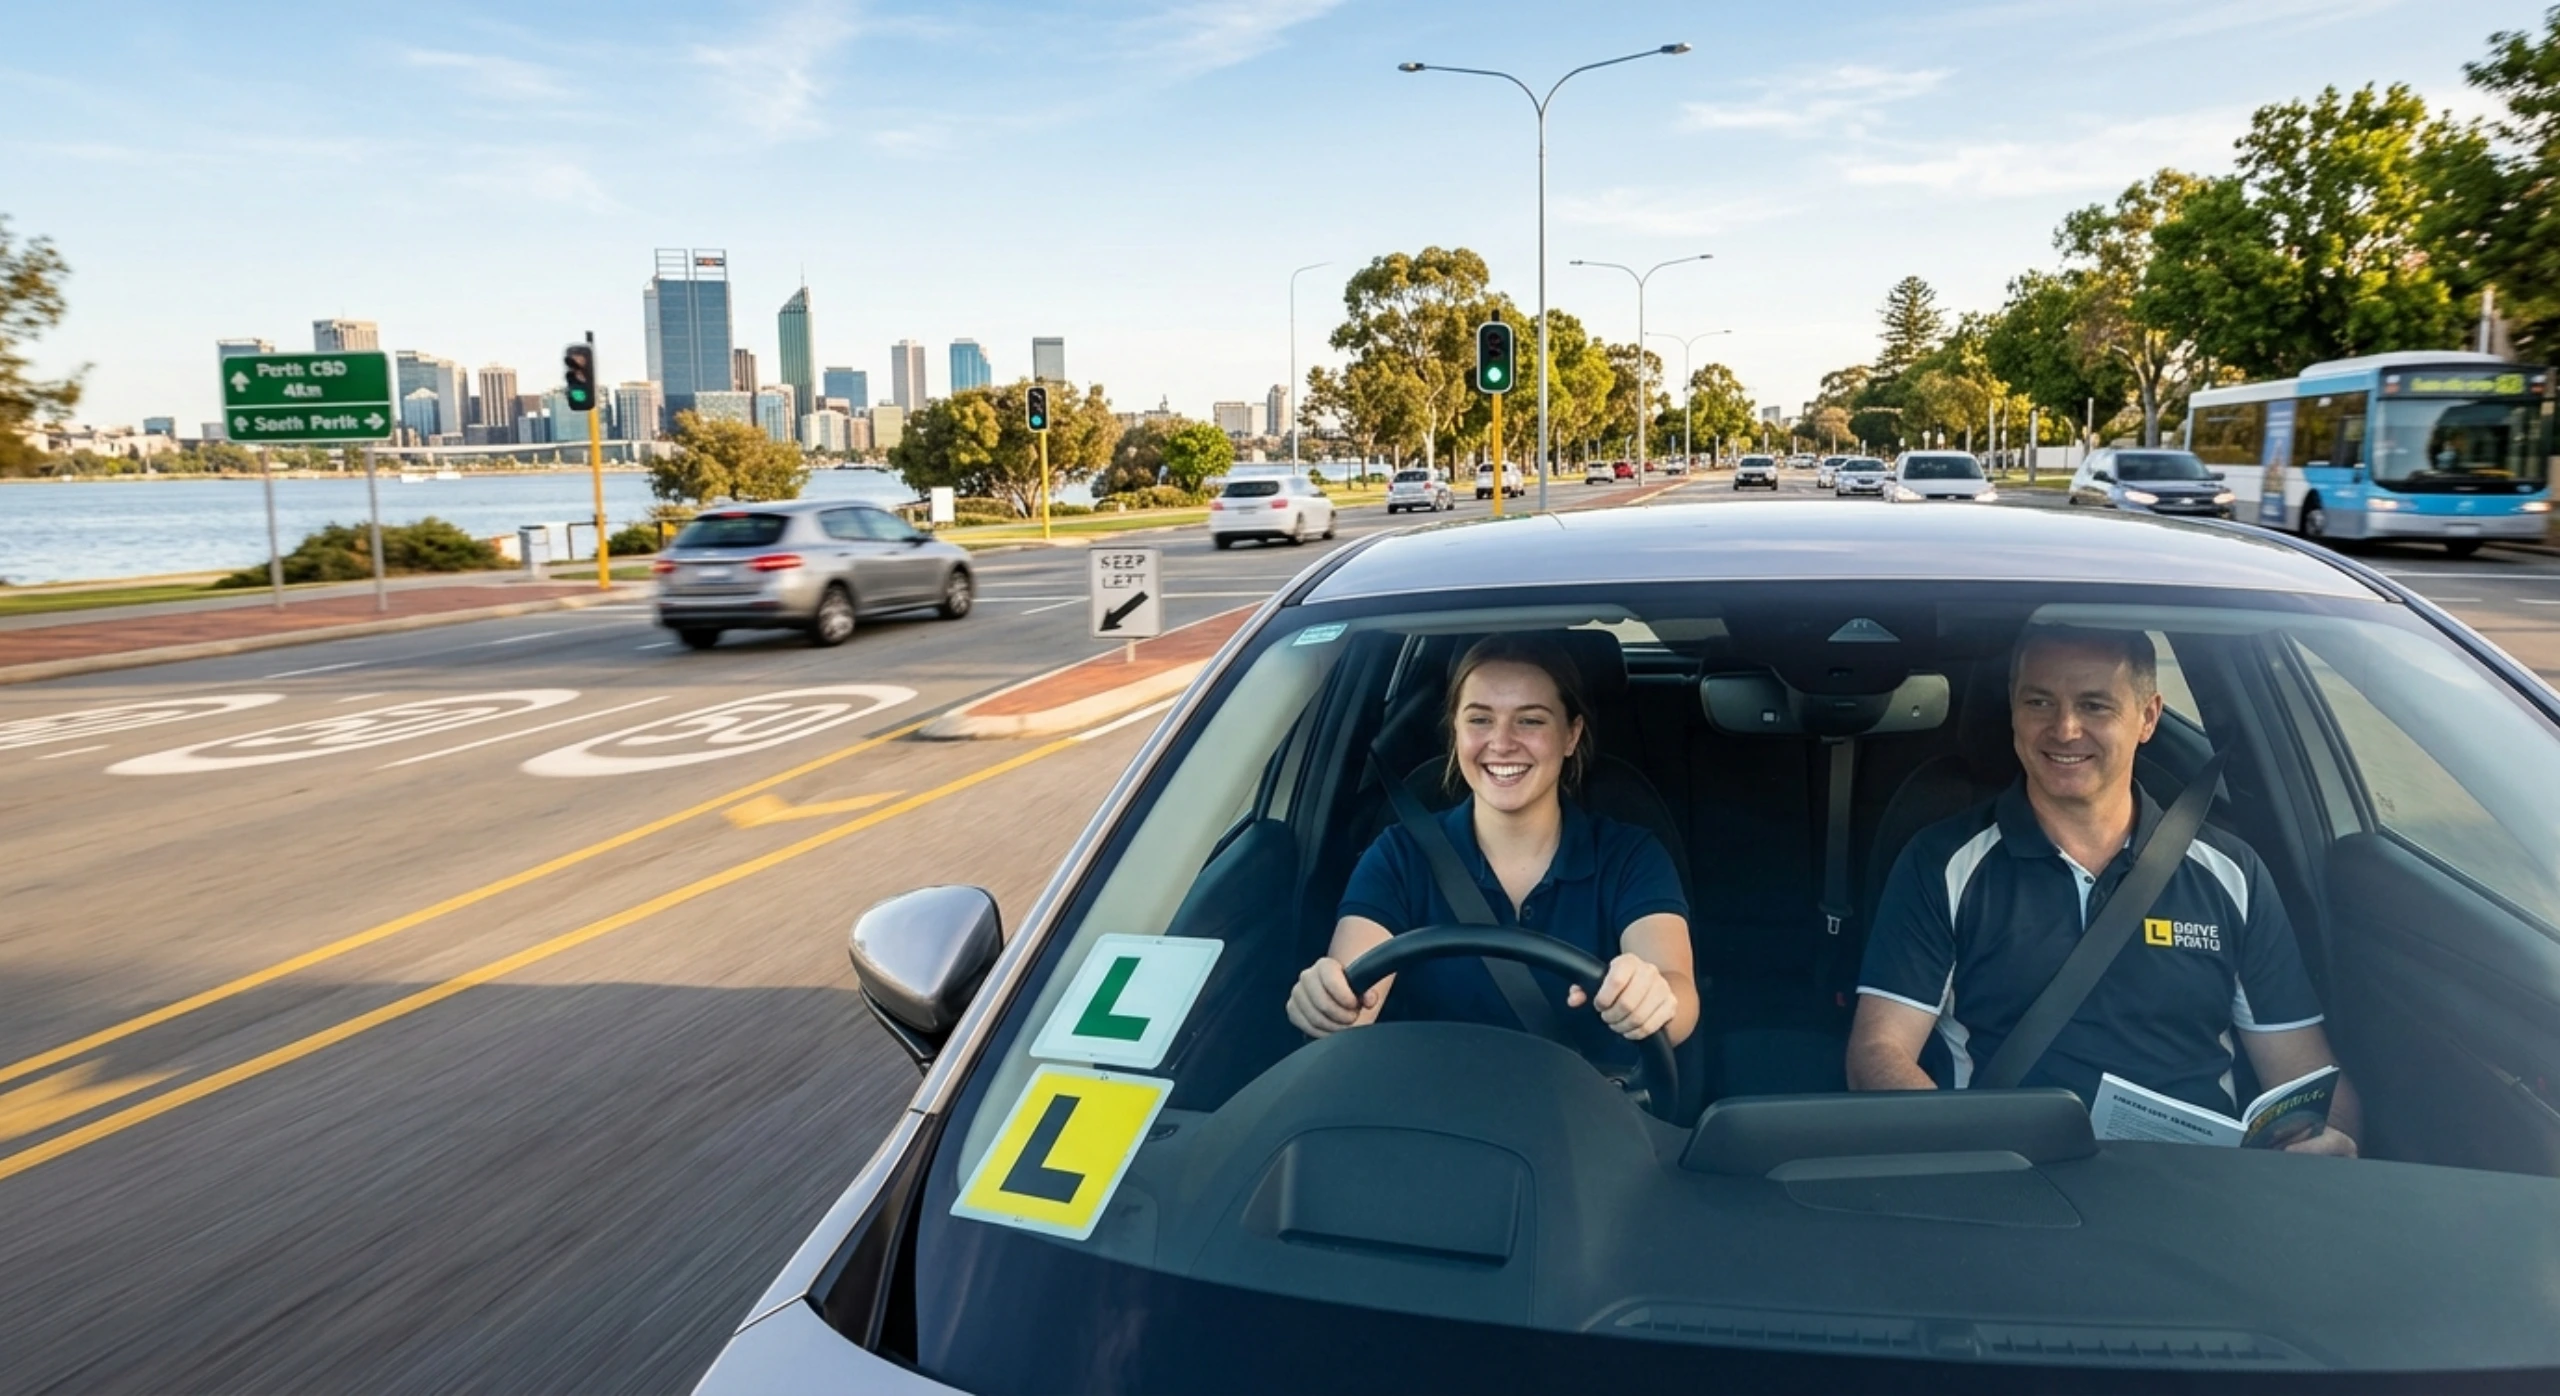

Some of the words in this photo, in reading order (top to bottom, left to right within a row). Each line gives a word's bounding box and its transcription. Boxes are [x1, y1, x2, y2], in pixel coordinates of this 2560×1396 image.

[617, 703, 852, 745] 50
[2151, 923, 2167, 940] L
[1072, 956, 1151, 1042] L
[999, 1094, 1085, 1204] L
